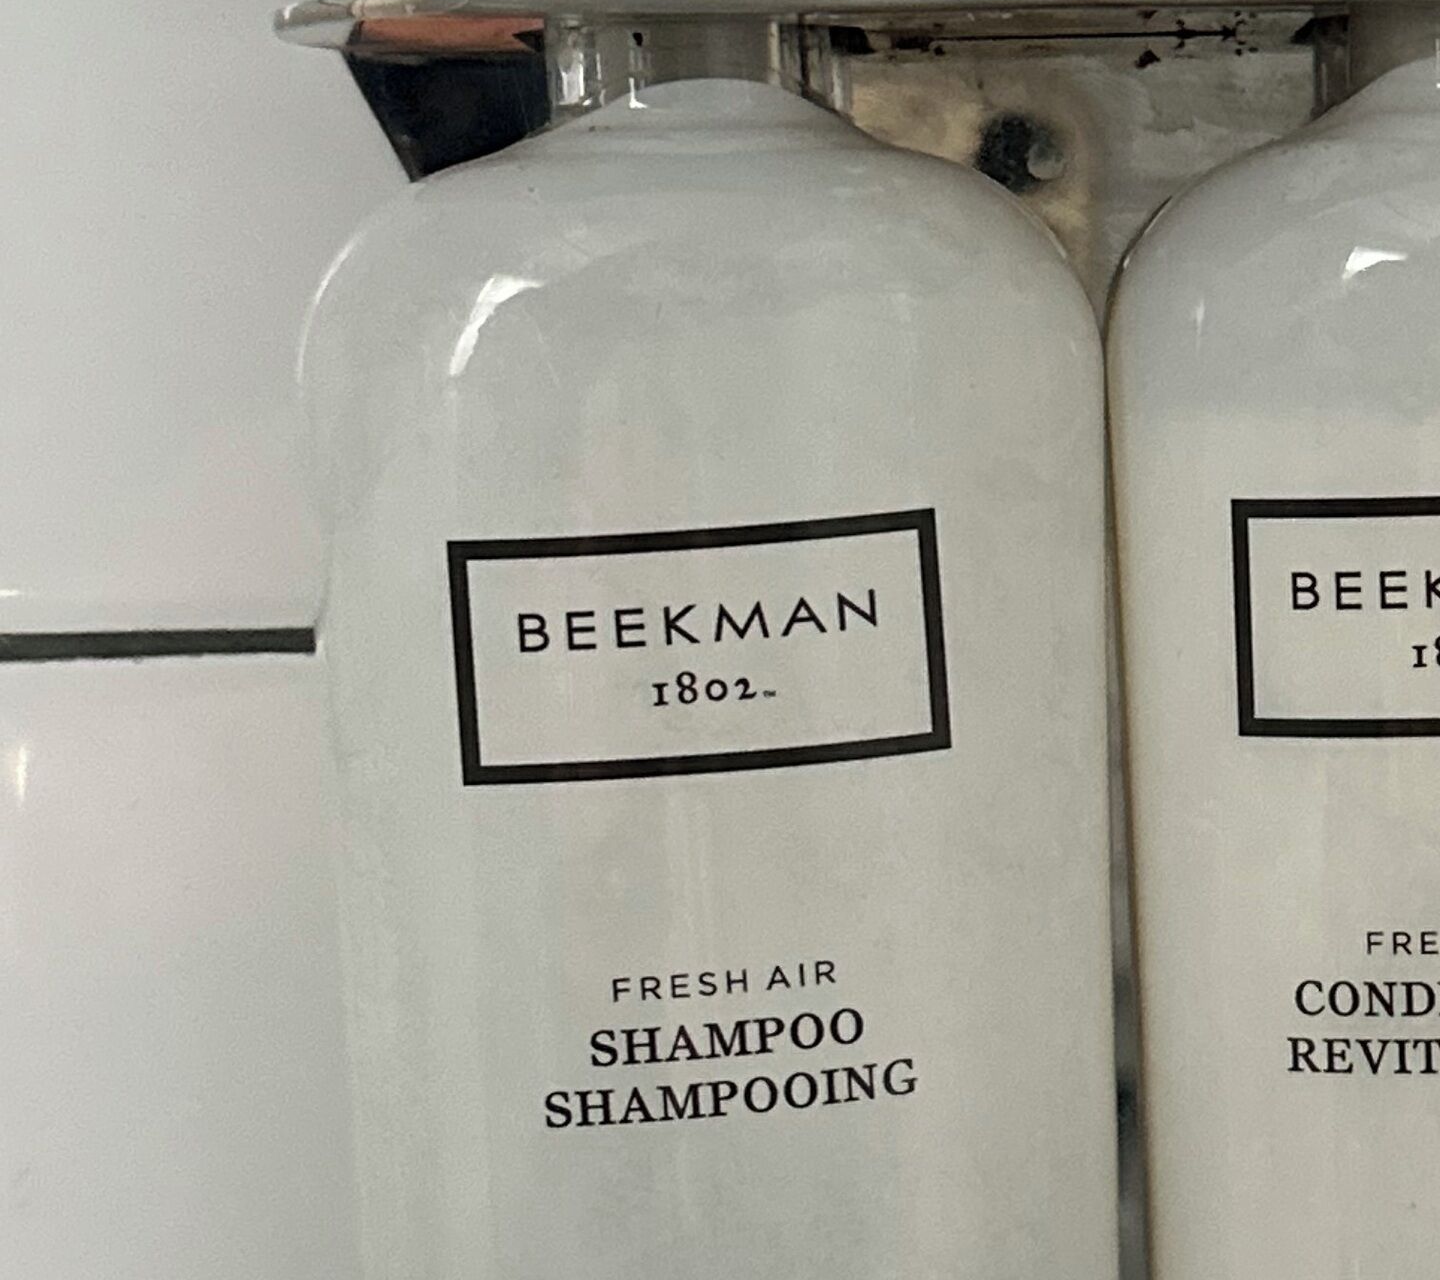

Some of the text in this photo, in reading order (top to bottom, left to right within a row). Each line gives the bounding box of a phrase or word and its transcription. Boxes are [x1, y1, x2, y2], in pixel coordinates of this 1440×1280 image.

[516, 587, 879, 654] BEEKMAN
[611, 959, 837, 1004] FRESH AIR
[589, 1007, 865, 1068] SHAMPOO
[543, 1057, 919, 1130] SHAMPOOING
